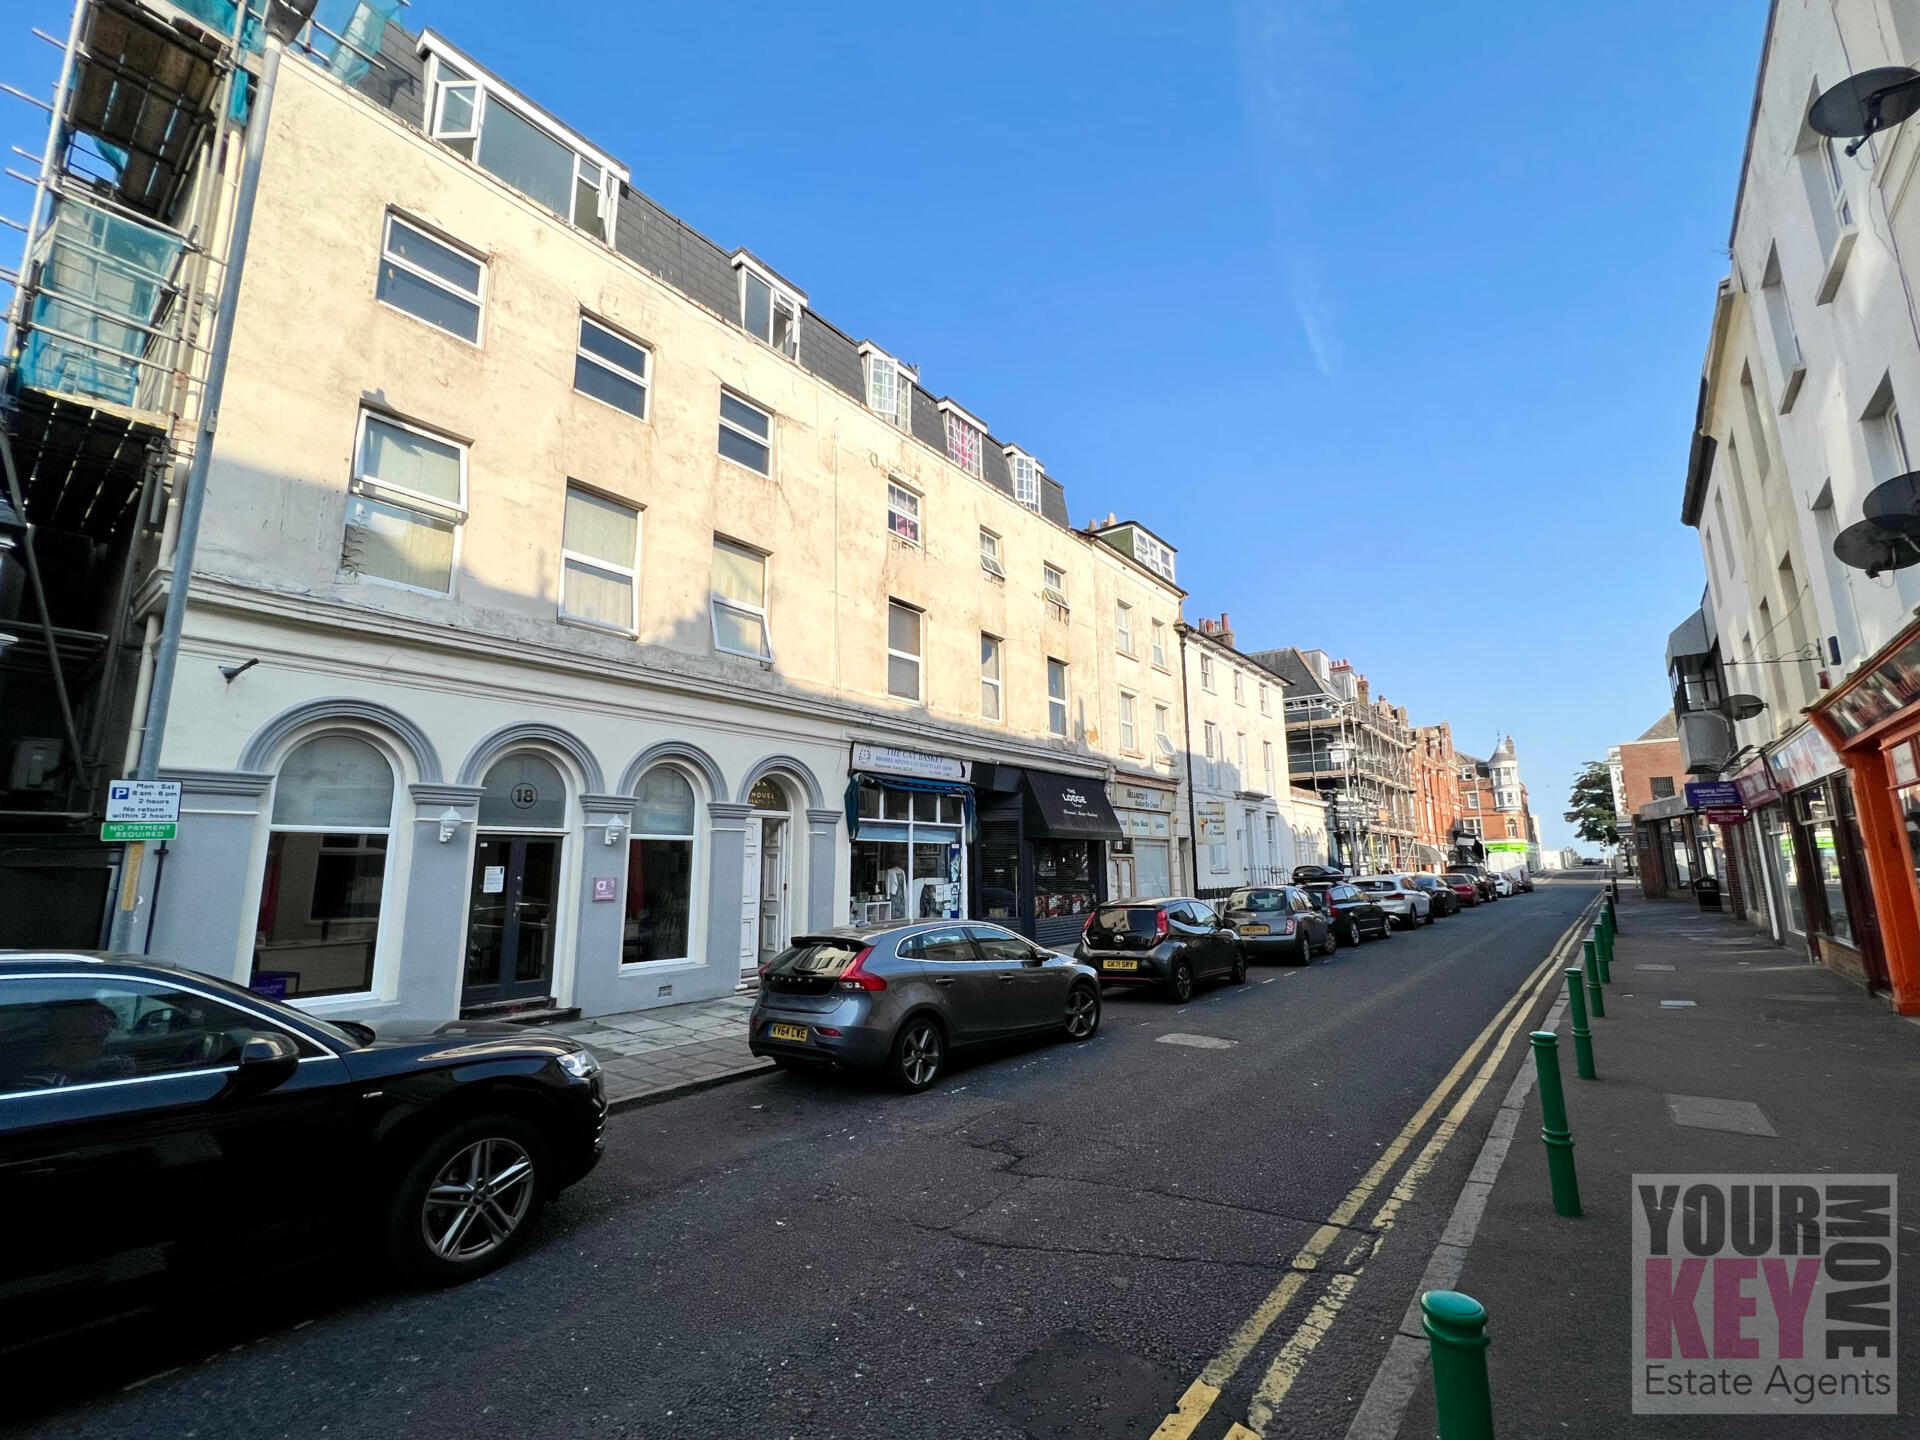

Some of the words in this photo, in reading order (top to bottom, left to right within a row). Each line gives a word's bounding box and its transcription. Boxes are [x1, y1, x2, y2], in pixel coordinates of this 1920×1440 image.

[887, 748, 900, 757] THE
[902, 751, 917, 760] CAT
[918, 753, 944, 764] BASKET
[516, 789, 534, 802] 18
[751, 792, 774, 800] HOUSE
[1062, 793, 1087, 804] LODGE
